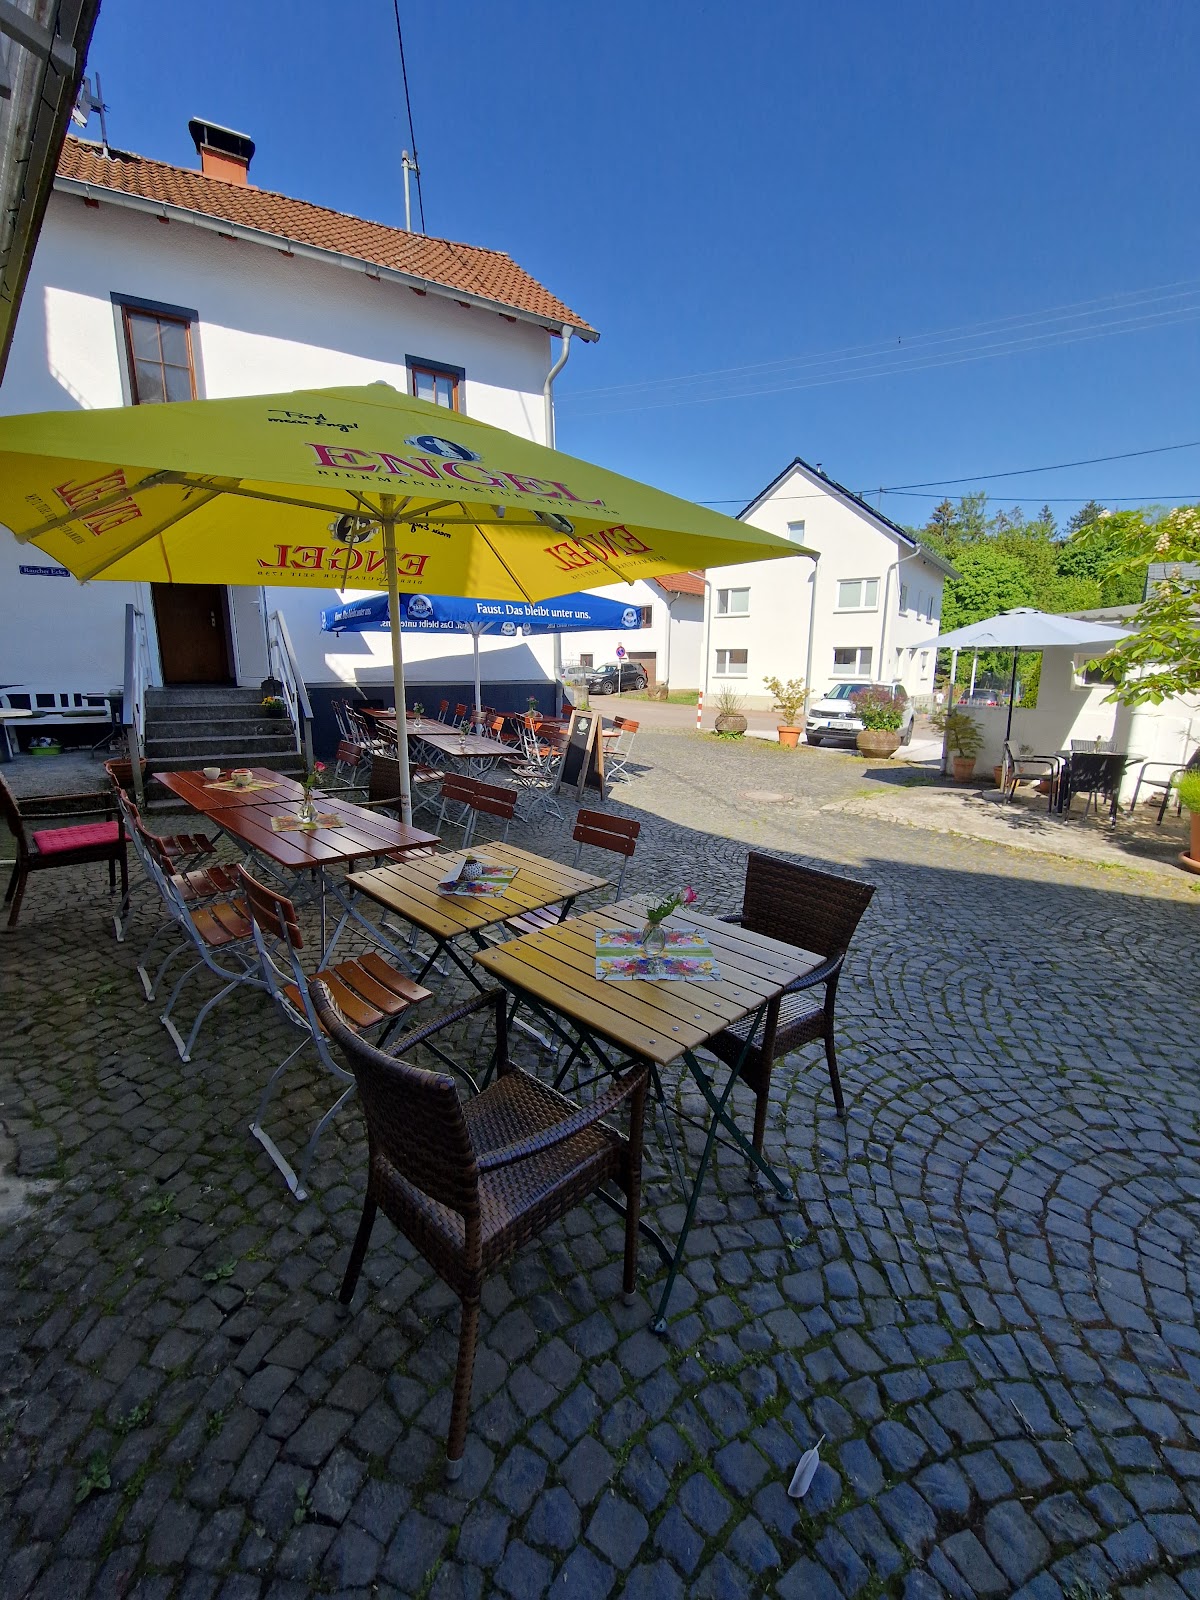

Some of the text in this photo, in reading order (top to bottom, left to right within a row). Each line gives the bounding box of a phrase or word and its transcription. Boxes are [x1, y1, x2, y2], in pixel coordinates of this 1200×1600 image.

[315, 420, 358, 432] Engel
[305, 442, 606, 506] ENGEL
[317, 470, 525, 499] BIERMANUFAKTUR
[476, 602, 591, 620] Faust. Das bleibt unter uns.
